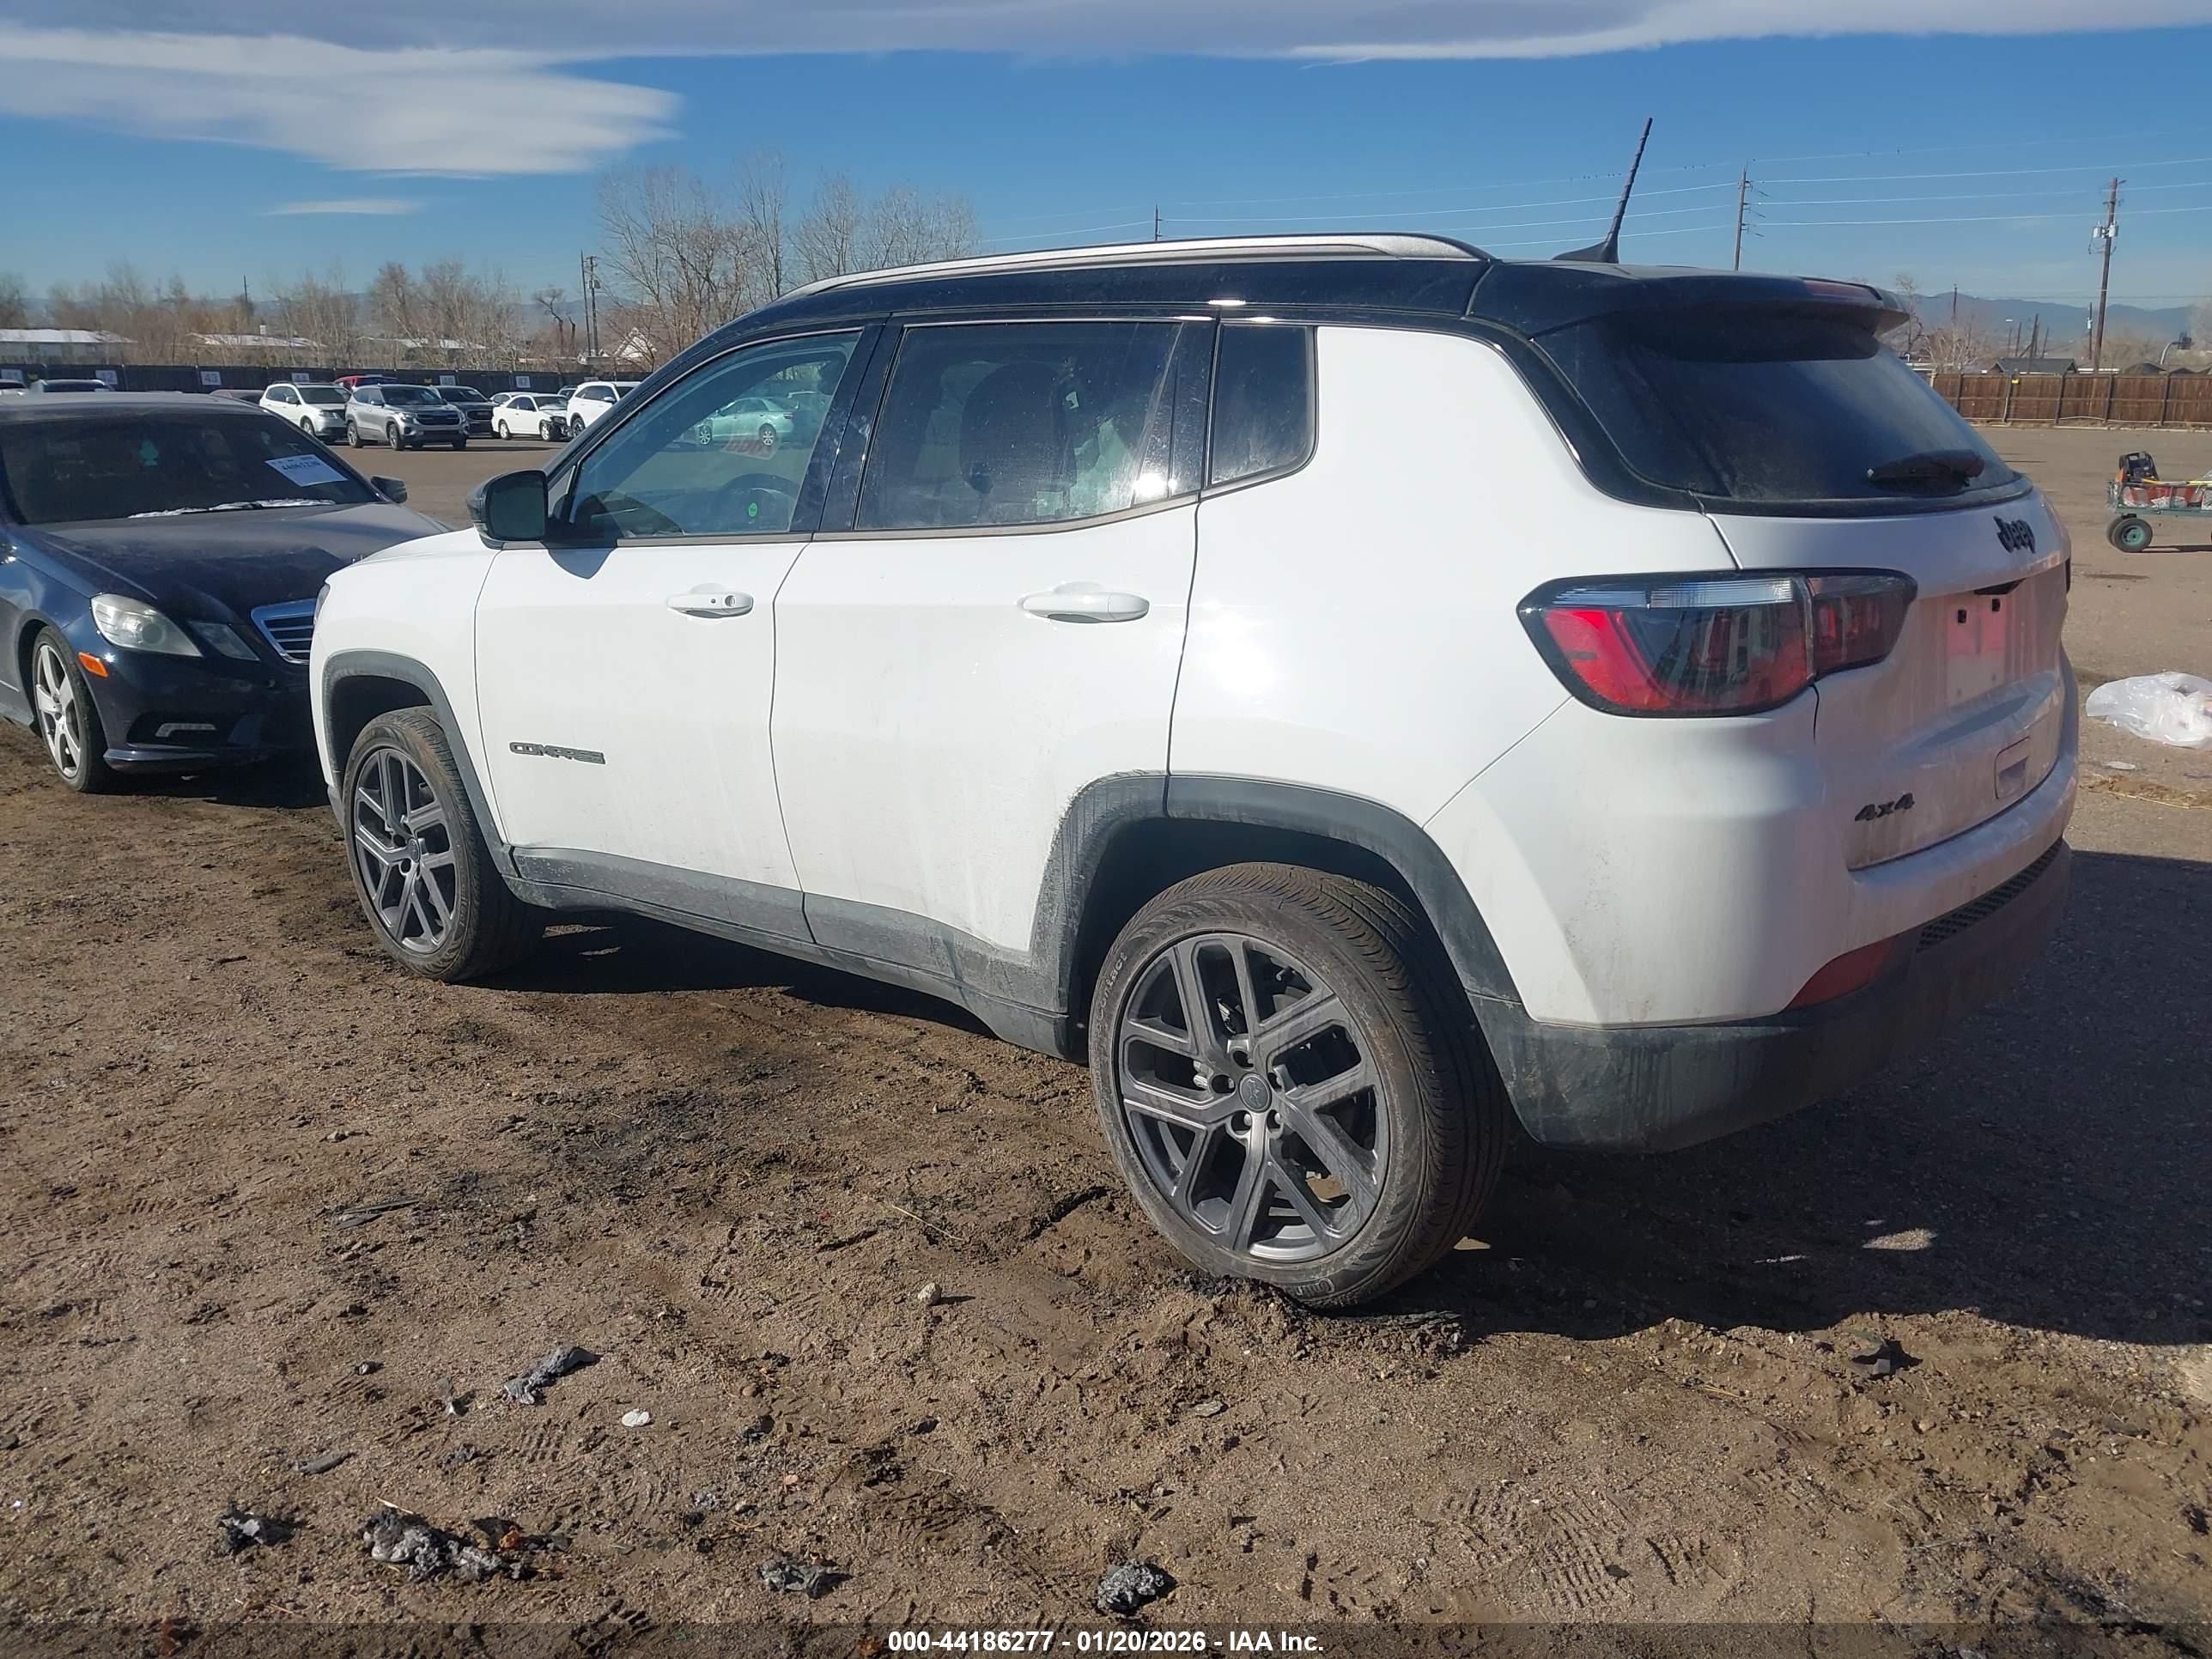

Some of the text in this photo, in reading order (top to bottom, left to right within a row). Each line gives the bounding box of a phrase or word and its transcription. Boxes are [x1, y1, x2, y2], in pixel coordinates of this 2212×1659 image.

[1993, 516, 2036, 554] Jeep
[509, 742, 605, 765] COMPASS
[1855, 793, 1915, 822] 4x4
